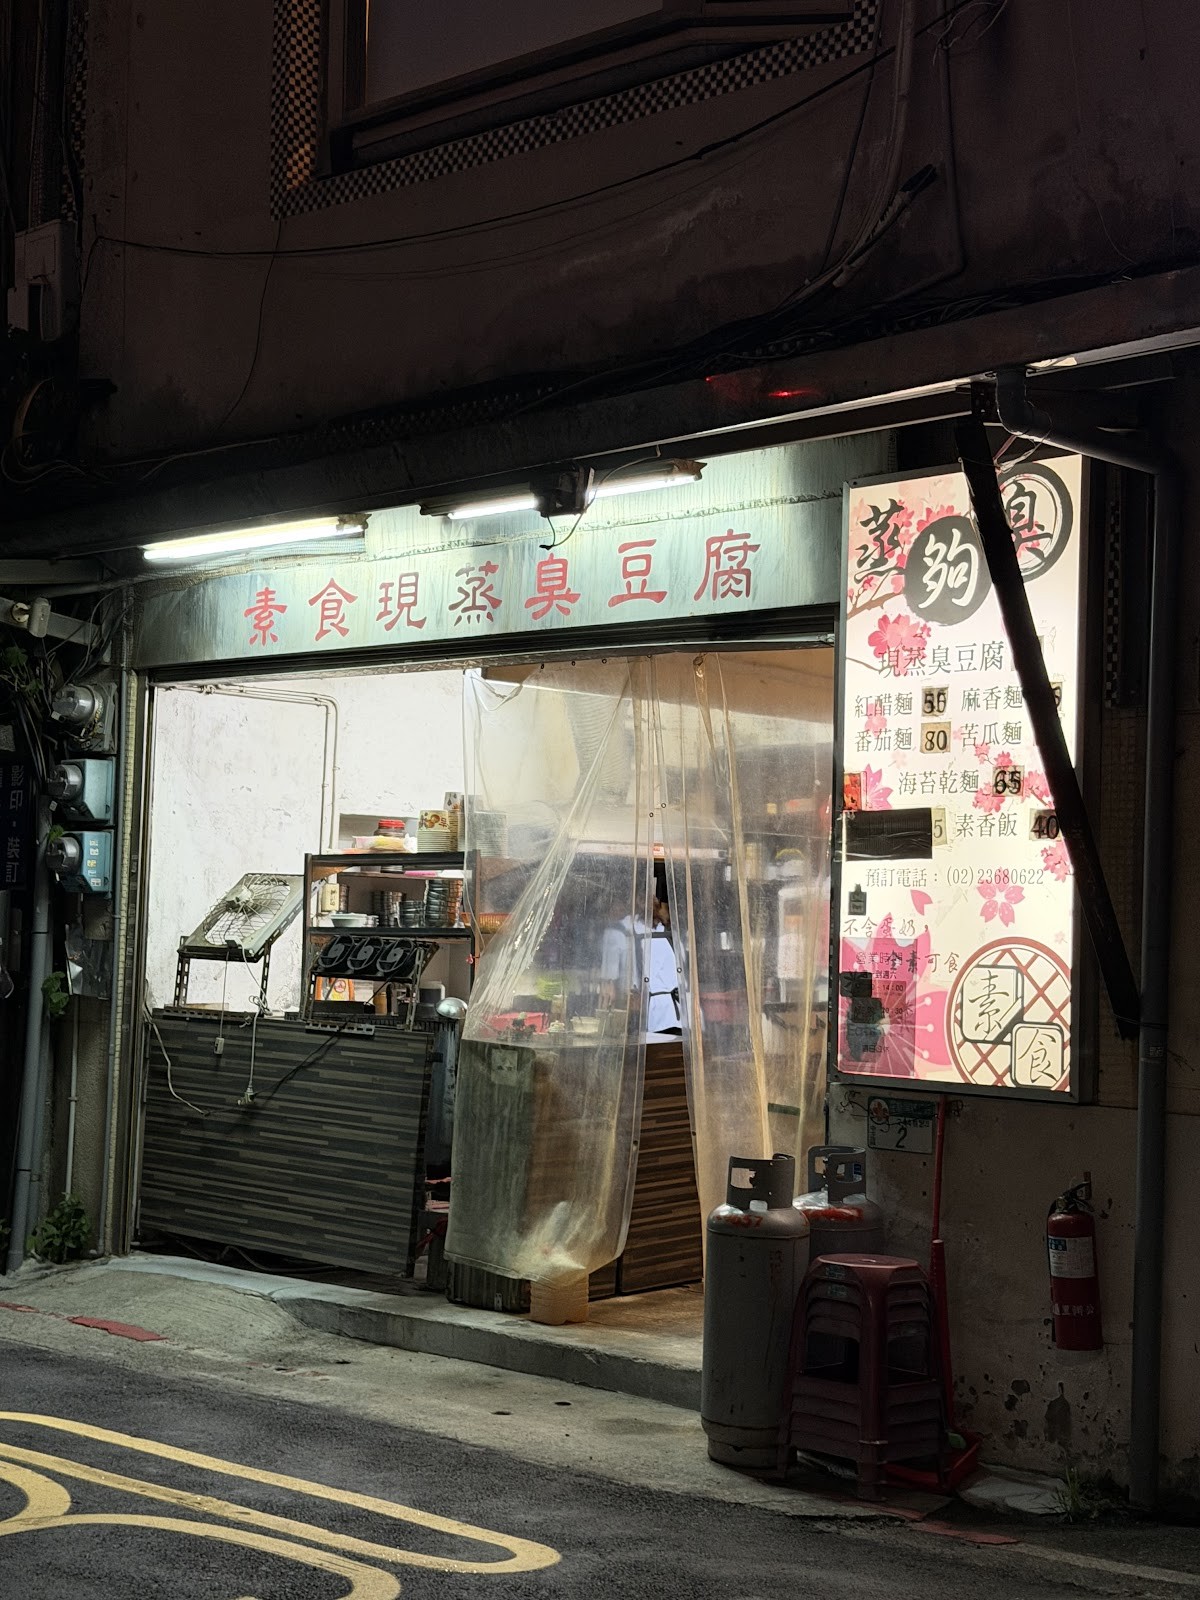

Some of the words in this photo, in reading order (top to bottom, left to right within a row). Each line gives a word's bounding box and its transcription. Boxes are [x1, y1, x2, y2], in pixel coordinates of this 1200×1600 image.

[243, 528, 761, 646] 素食現蒸臭豆腐
[878, 640, 1004, 678] 現蒸臭豆腐
[854, 691, 913, 718] 紅醋麵
[961, 685, 1023, 713] 麻香麵
[854, 726, 913, 753] 番茄麵
[924, 729, 948, 751] 80
[960, 720, 1022, 748] 苦瓜麵
[898, 769, 979, 795] 海苔乾麵
[955, 812, 1018, 838] 素香飯
[947, 867, 1044, 885] (02)23680622
[968, 970, 1057, 1083] 素食
[896, 1125, 907, 1148] 2
